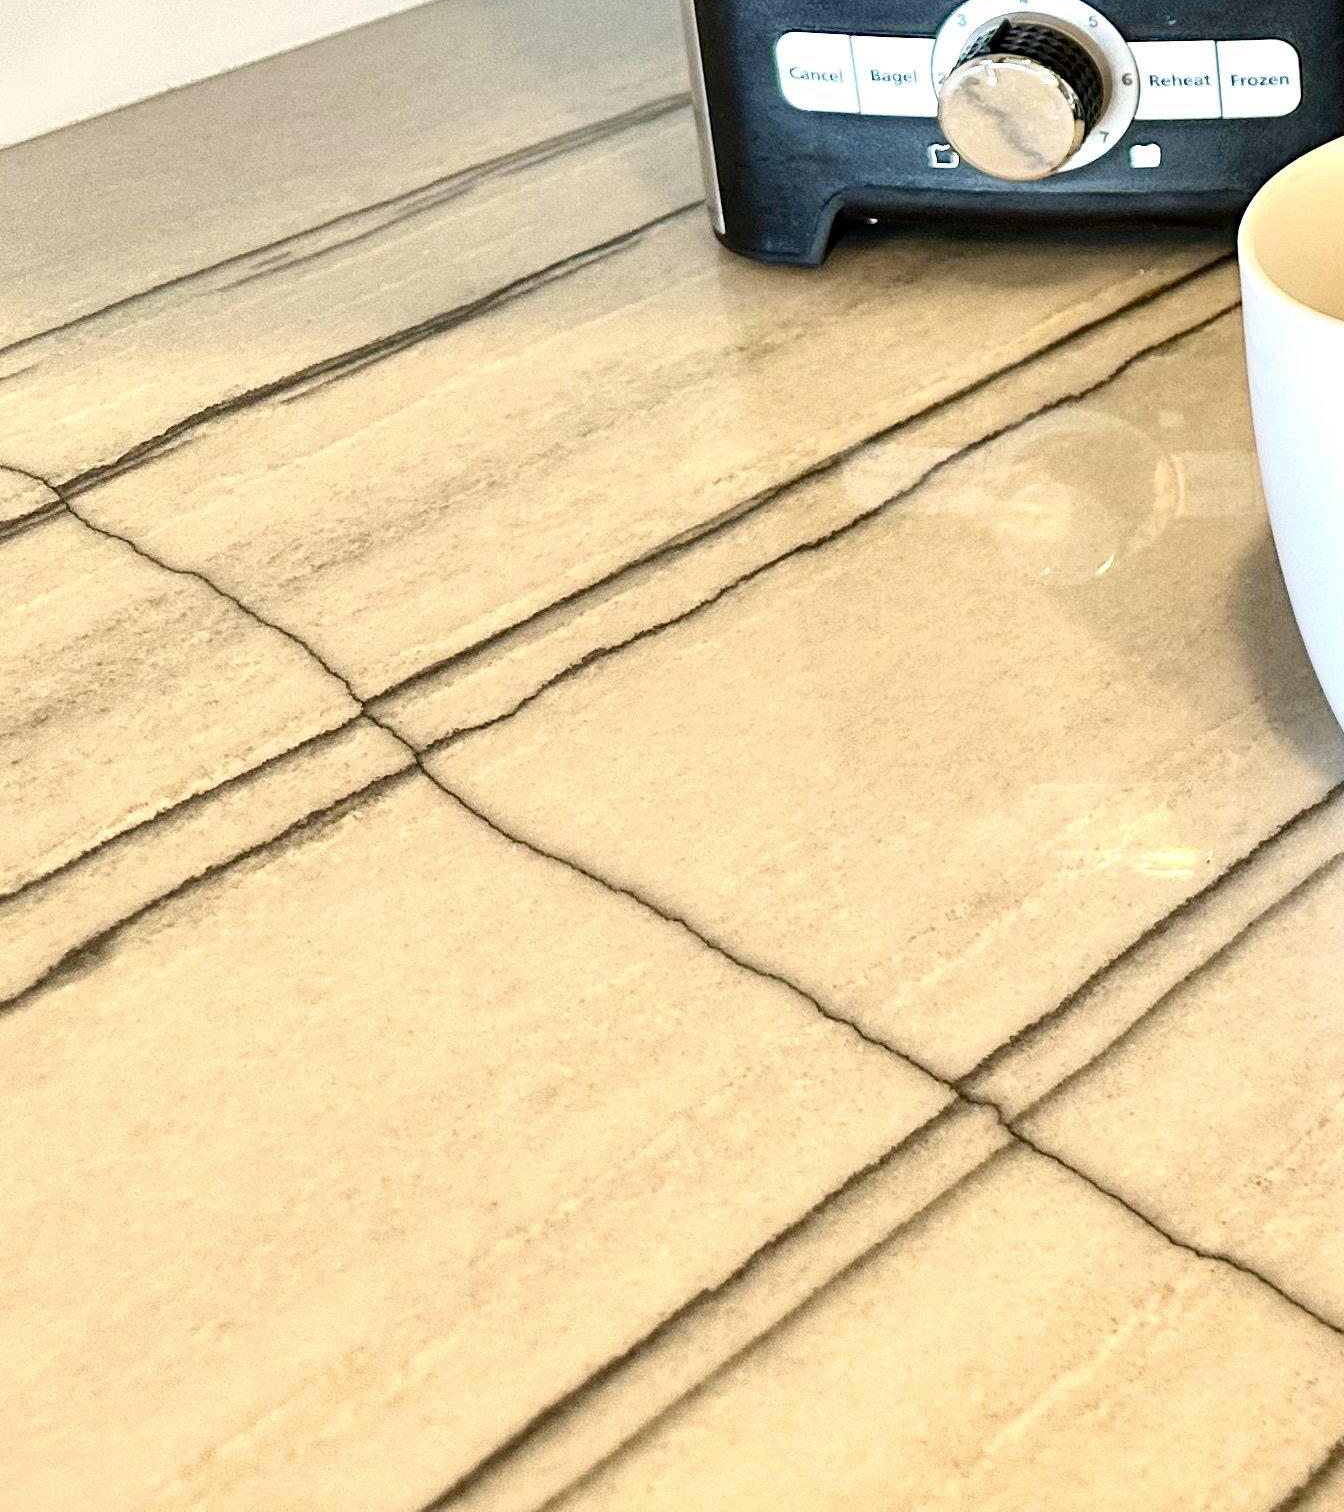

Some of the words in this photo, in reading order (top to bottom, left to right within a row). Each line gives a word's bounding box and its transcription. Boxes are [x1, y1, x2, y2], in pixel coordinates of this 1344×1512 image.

[957, 14, 967, 26] 3
[1088, 15, 1098, 28] 5
[790, 67, 843, 83] Cancel
[871, 69, 917, 86] Bagel
[1122, 73, 1133, 86] 6
[1149, 73, 1211, 87] Reheat
[1231, 74, 1290, 87] Frozen
[1100, 130, 1110, 143] 7
